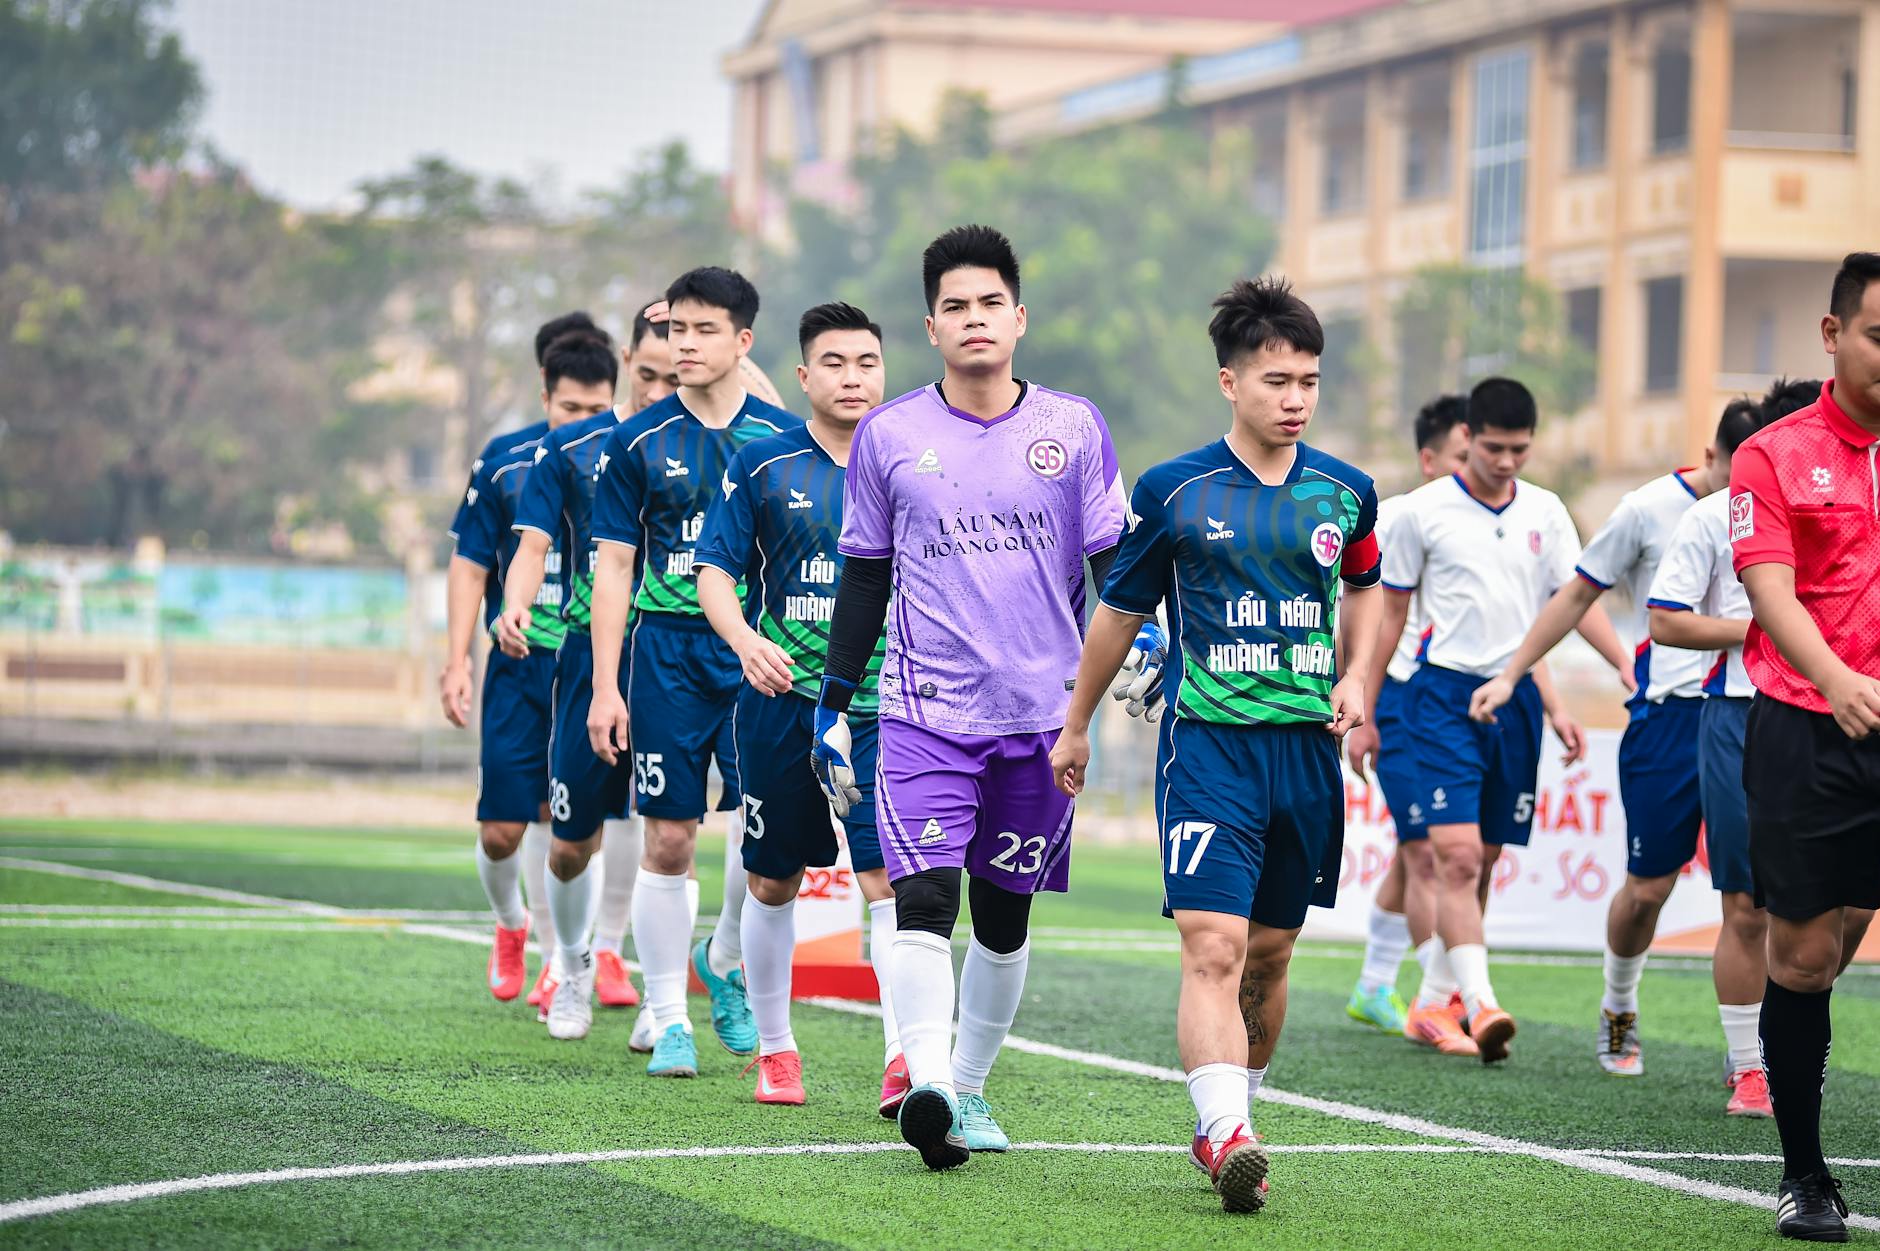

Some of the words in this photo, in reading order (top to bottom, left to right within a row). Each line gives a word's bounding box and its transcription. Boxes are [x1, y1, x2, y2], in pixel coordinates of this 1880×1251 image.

[682, 511, 705, 541] LẨ
[938, 507, 984, 536] LẨU
[991, 504, 1045, 531] NẤM
[1206, 529, 1234, 541] KAMITO
[1734, 523, 1751, 537] VPF
[923, 536, 999, 559] HOÀNG
[1003, 531, 1056, 551] QUÂN
[800, 552, 836, 584] LẨU
[785, 592, 836, 622] HOÀN
[1226, 591, 1267, 627] LẨU
[1279, 594, 1321, 628] NẤM
[1209, 638, 1279, 673] HOÀNG
[1292, 641, 1334, 676] QUÂN
[636, 753, 666, 797] 55
[1513, 791, 1535, 824] 5
[1536, 768, 1608, 833] HẤT
[918, 833, 947, 845] aspeed
[989, 832, 1047, 874] 23
[1168, 821, 1217, 875] 17
